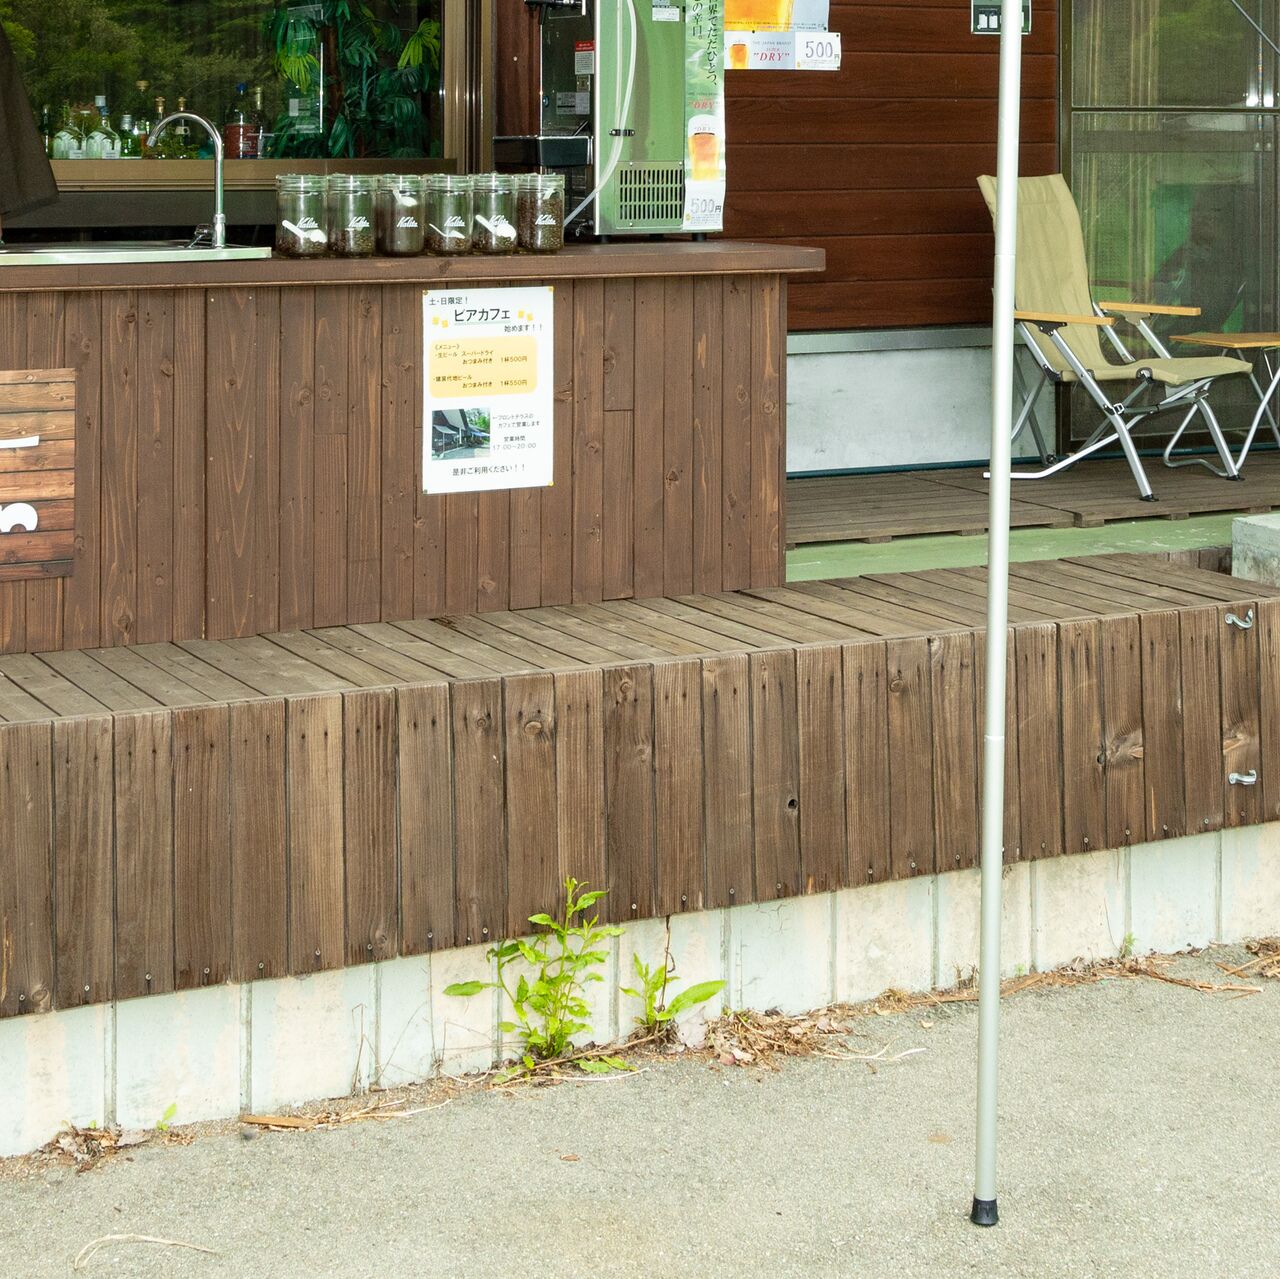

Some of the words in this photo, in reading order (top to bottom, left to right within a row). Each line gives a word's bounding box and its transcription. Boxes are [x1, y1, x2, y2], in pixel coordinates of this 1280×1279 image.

[429, 296, 468, 306] 土・日限定！
[454, 308, 510, 322] ビアカフェ
